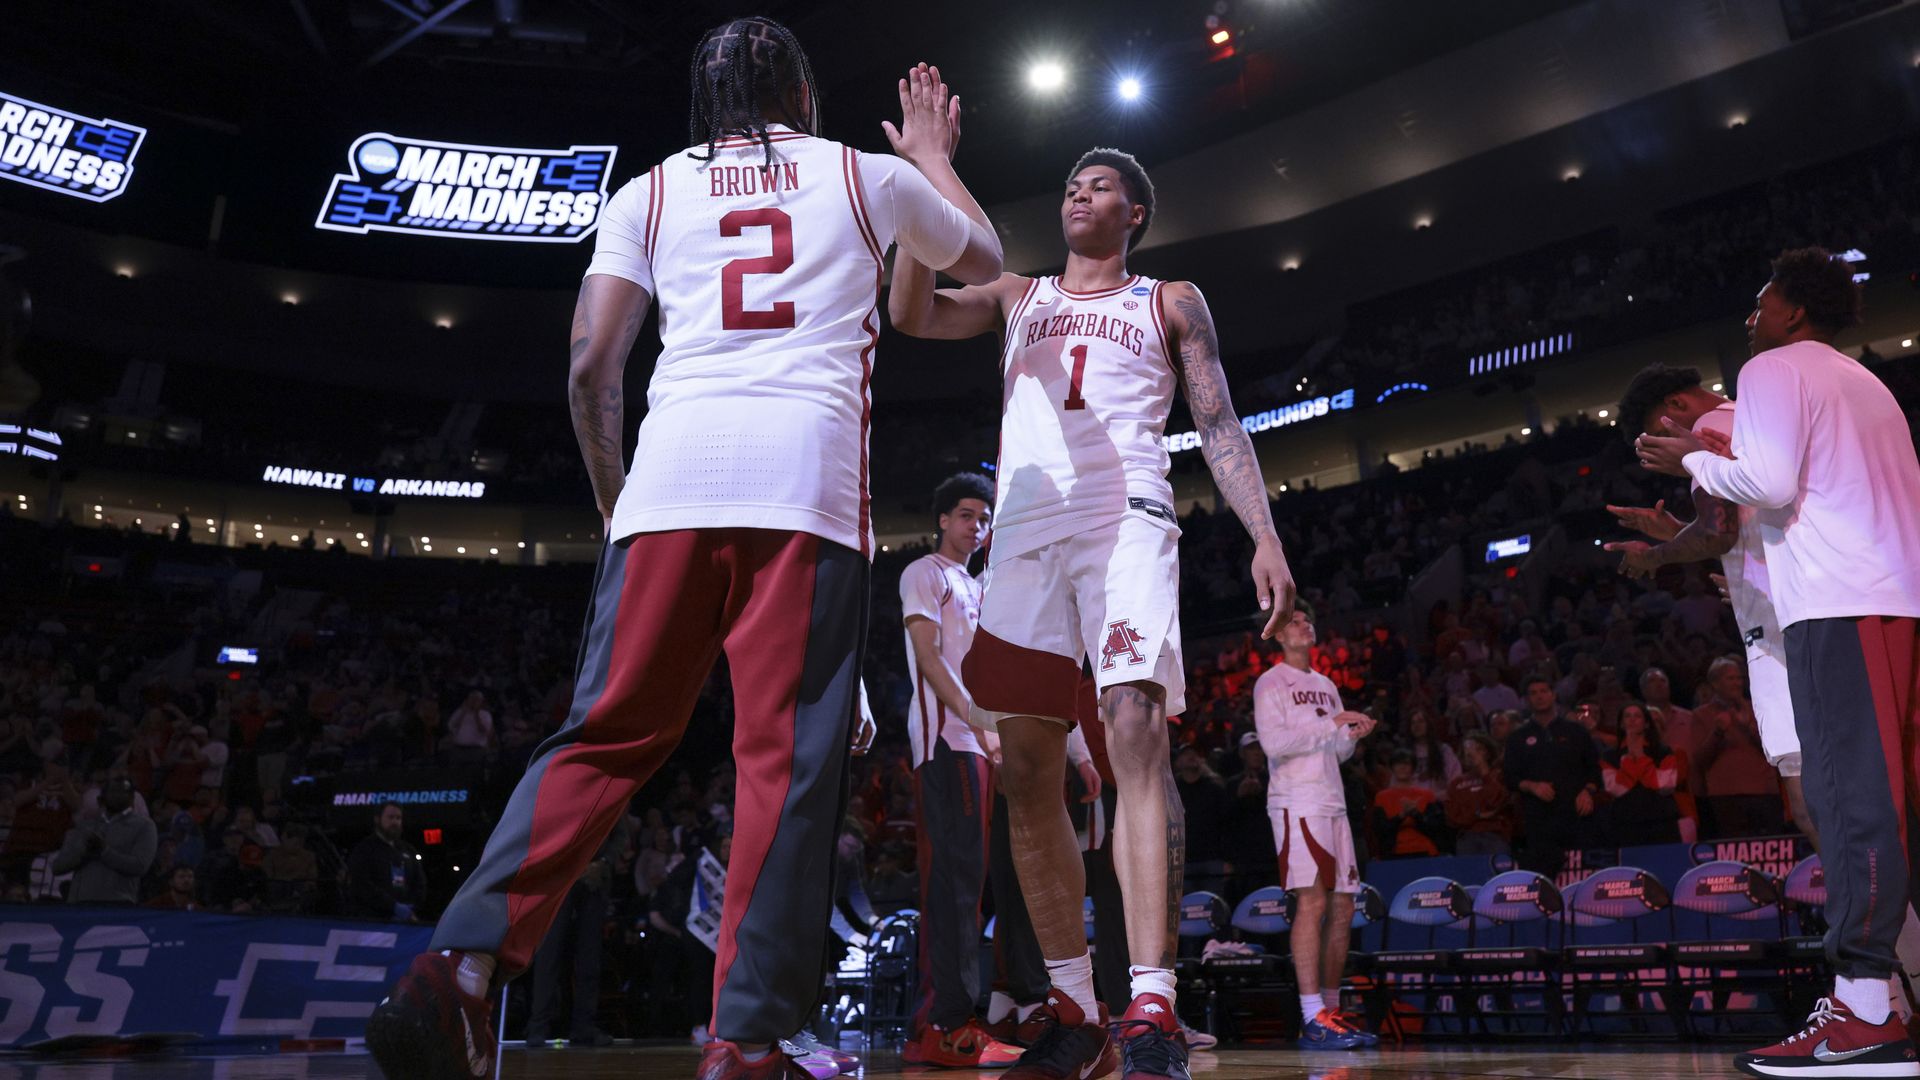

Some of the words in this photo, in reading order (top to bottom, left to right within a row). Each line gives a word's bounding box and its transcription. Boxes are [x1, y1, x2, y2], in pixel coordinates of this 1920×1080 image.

[395, 146, 541, 191] MARCH
[709, 162, 799, 196] BROWN
[407, 183, 600, 226] MADNESS
[719, 208, 795, 330] 2
[1025, 313, 1144, 357] RAZORBACKS
[1064, 344, 1088, 410] 1
[1242, 396, 1330, 433] ROUNDS
[263, 465, 346, 490] HAWAII
[352, 477, 375, 492] VS
[379, 478, 485, 498] ARKANSAS
[333, 789, 468, 806] #MARCHMADNESS
[1716, 838, 1794, 862] MARCH
